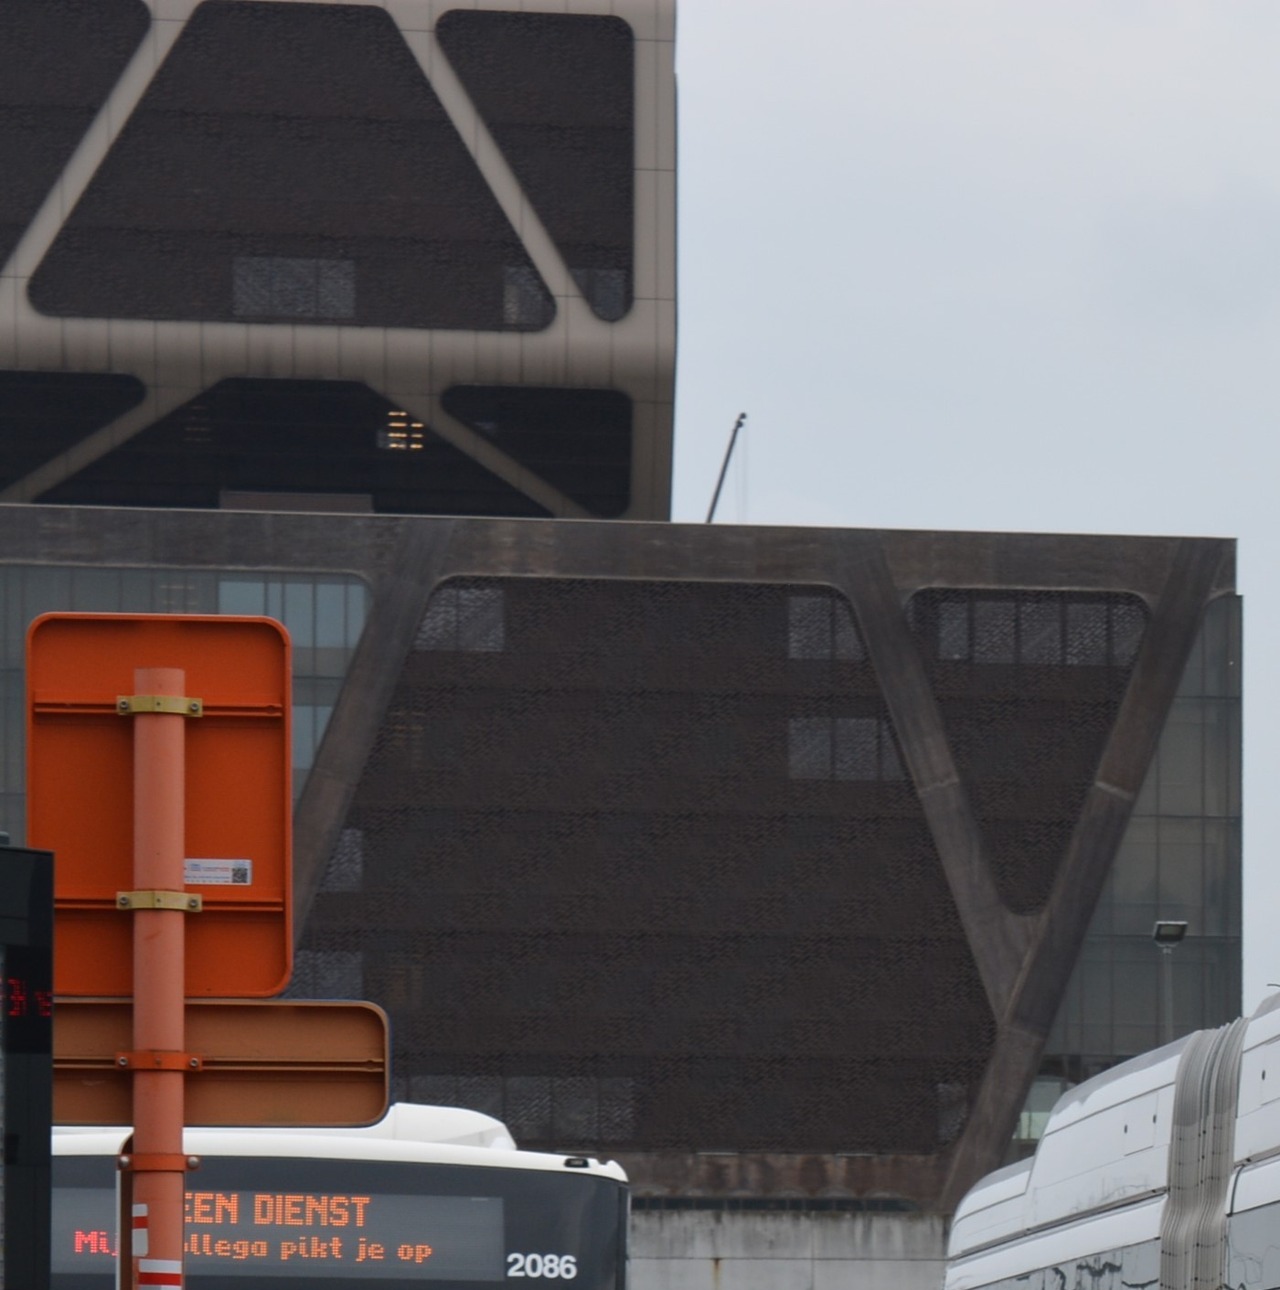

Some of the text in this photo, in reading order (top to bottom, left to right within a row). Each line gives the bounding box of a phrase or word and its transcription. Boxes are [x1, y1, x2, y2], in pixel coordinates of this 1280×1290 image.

[254, 1195, 371, 1227] DIENST
[280, 1236, 347, 1261] pikt
[356, 1238, 386, 1261] je
[397, 1242, 432, 1264] op
[507, 1253, 577, 1280] 2086
